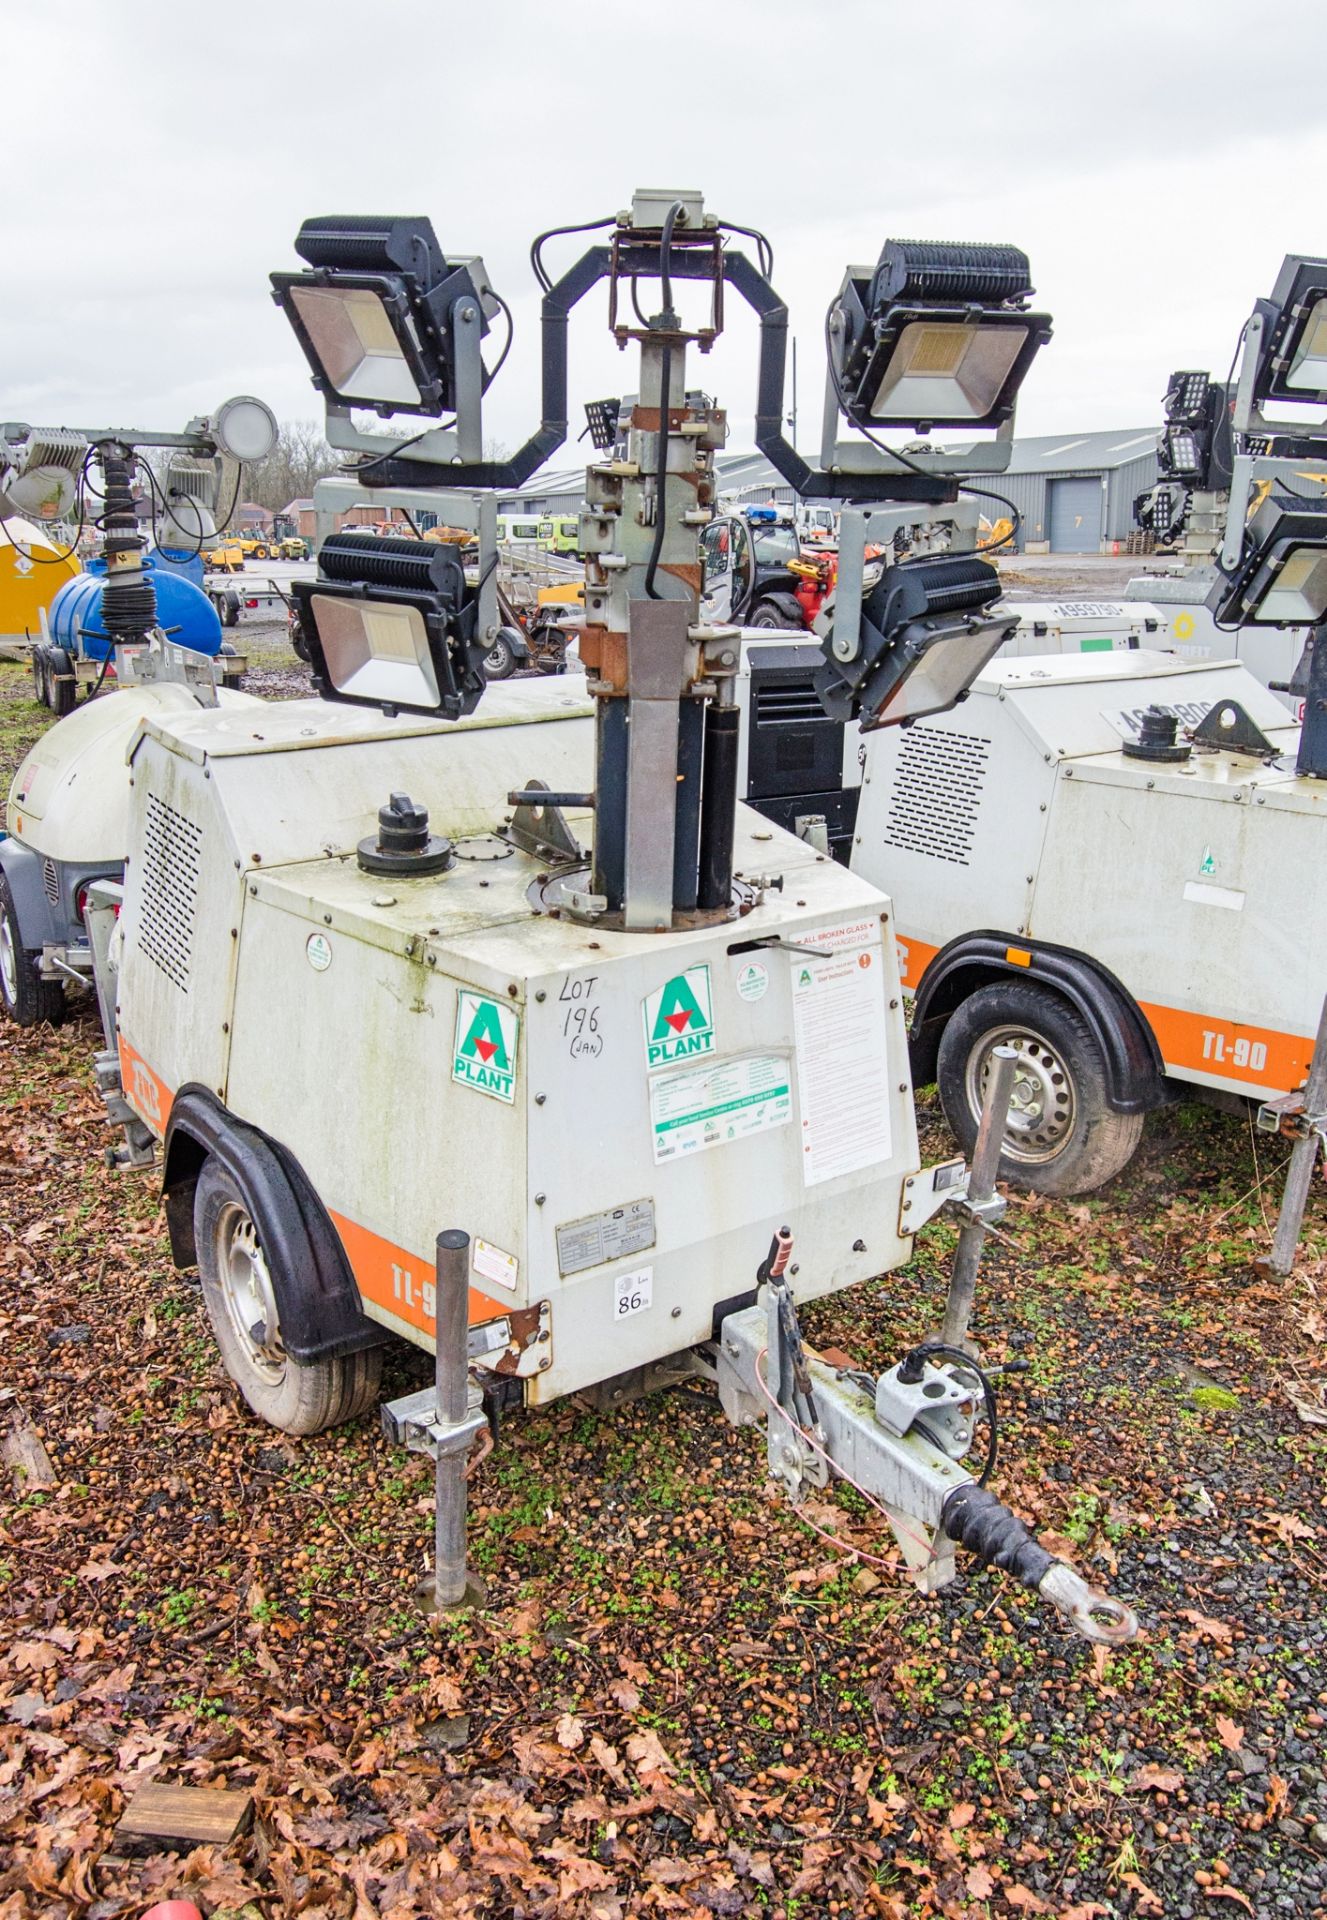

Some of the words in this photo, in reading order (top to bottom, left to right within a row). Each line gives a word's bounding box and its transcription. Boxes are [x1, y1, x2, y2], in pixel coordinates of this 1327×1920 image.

[1074, 515, 1082, 528] 7
[803, 936, 816, 945] ALL
[818, 928, 845, 940] BROKEN
[846, 923, 868, 934] GLASS
[559, 972, 599, 1002] LOT
[564, 1005, 600, 1037] 196
[569, 1033, 604, 1060] (JAN)
[648, 1031, 714, 1064] PLANT
[1202, 1030, 1268, 1071] TL-90
[454, 1058, 513, 1095] PLANT
[391, 1263, 436, 1319] TL-9
[619, 1291, 641, 1314] 86
